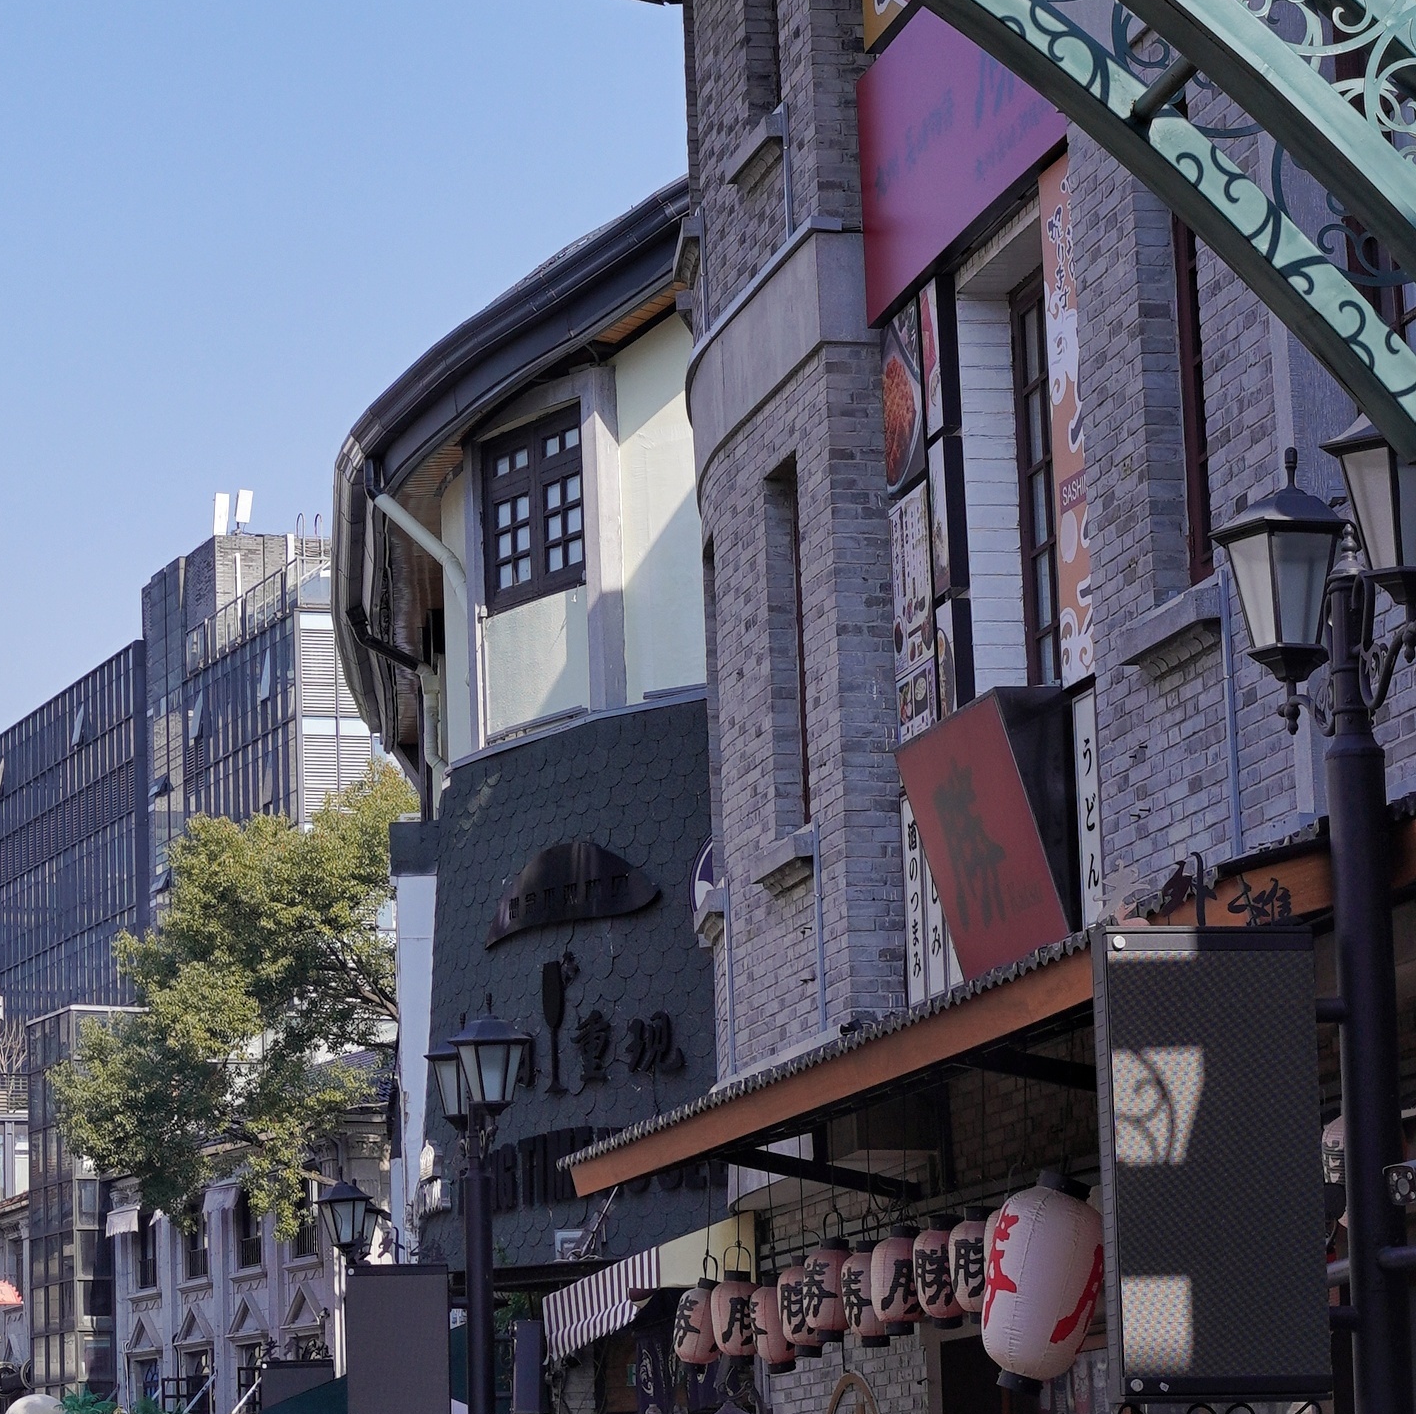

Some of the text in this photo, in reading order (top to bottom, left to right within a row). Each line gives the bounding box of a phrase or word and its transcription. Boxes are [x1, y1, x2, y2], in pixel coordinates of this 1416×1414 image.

[1062, 473, 1086, 507] SASHI
[1082, 737, 1100, 891] うどん
[906, 817, 922, 979] 酒のつまみ
